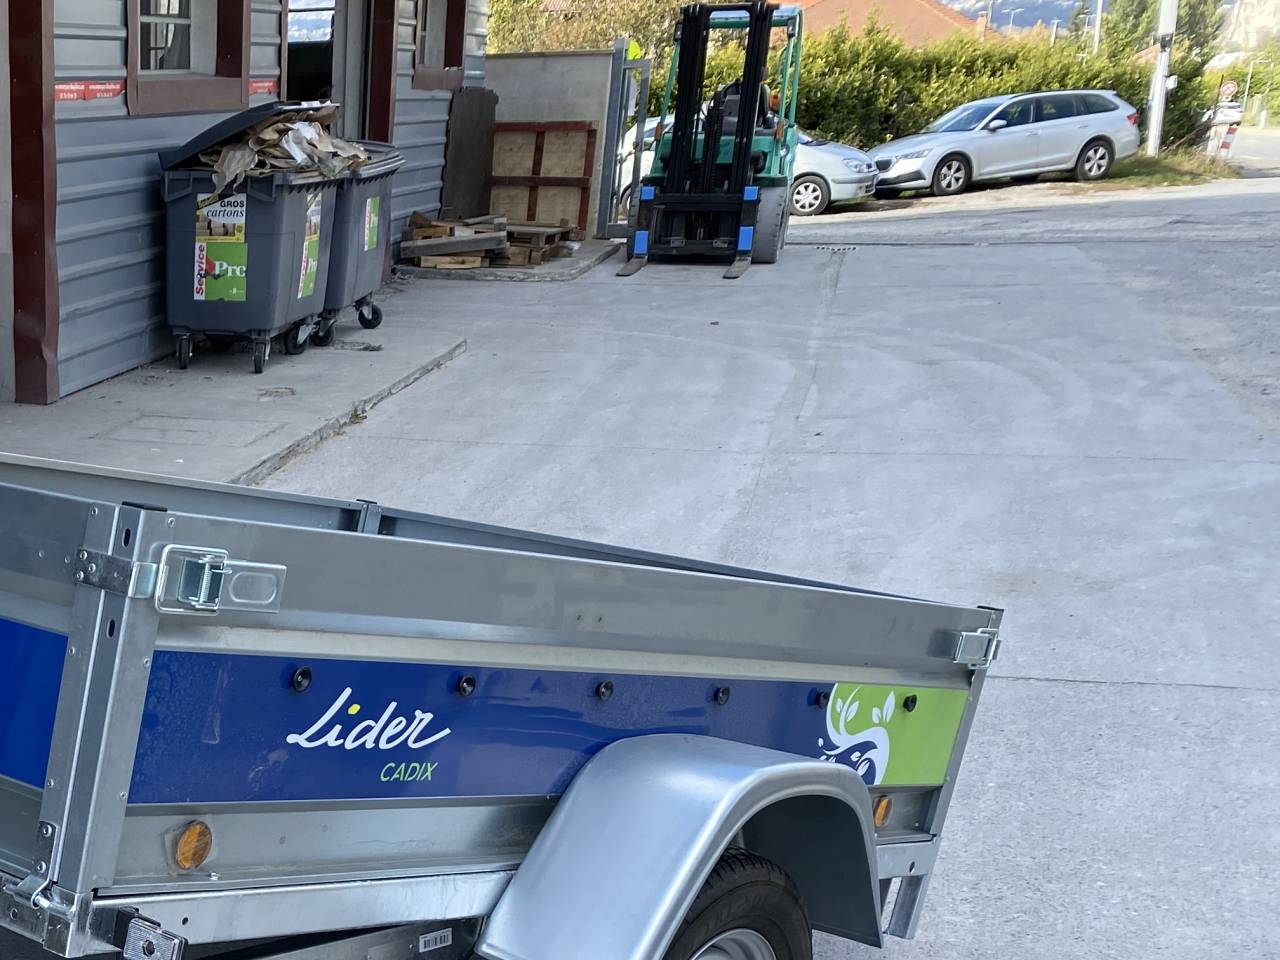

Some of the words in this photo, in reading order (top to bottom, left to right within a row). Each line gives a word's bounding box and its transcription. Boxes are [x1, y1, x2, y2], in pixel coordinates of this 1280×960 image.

[206, 208, 245, 218] cartons
[220, 200, 245, 208] GROS
[195, 244, 206, 296] Service
[286, 686, 452, 750] Lider
[380, 762, 439, 782] CADIX
